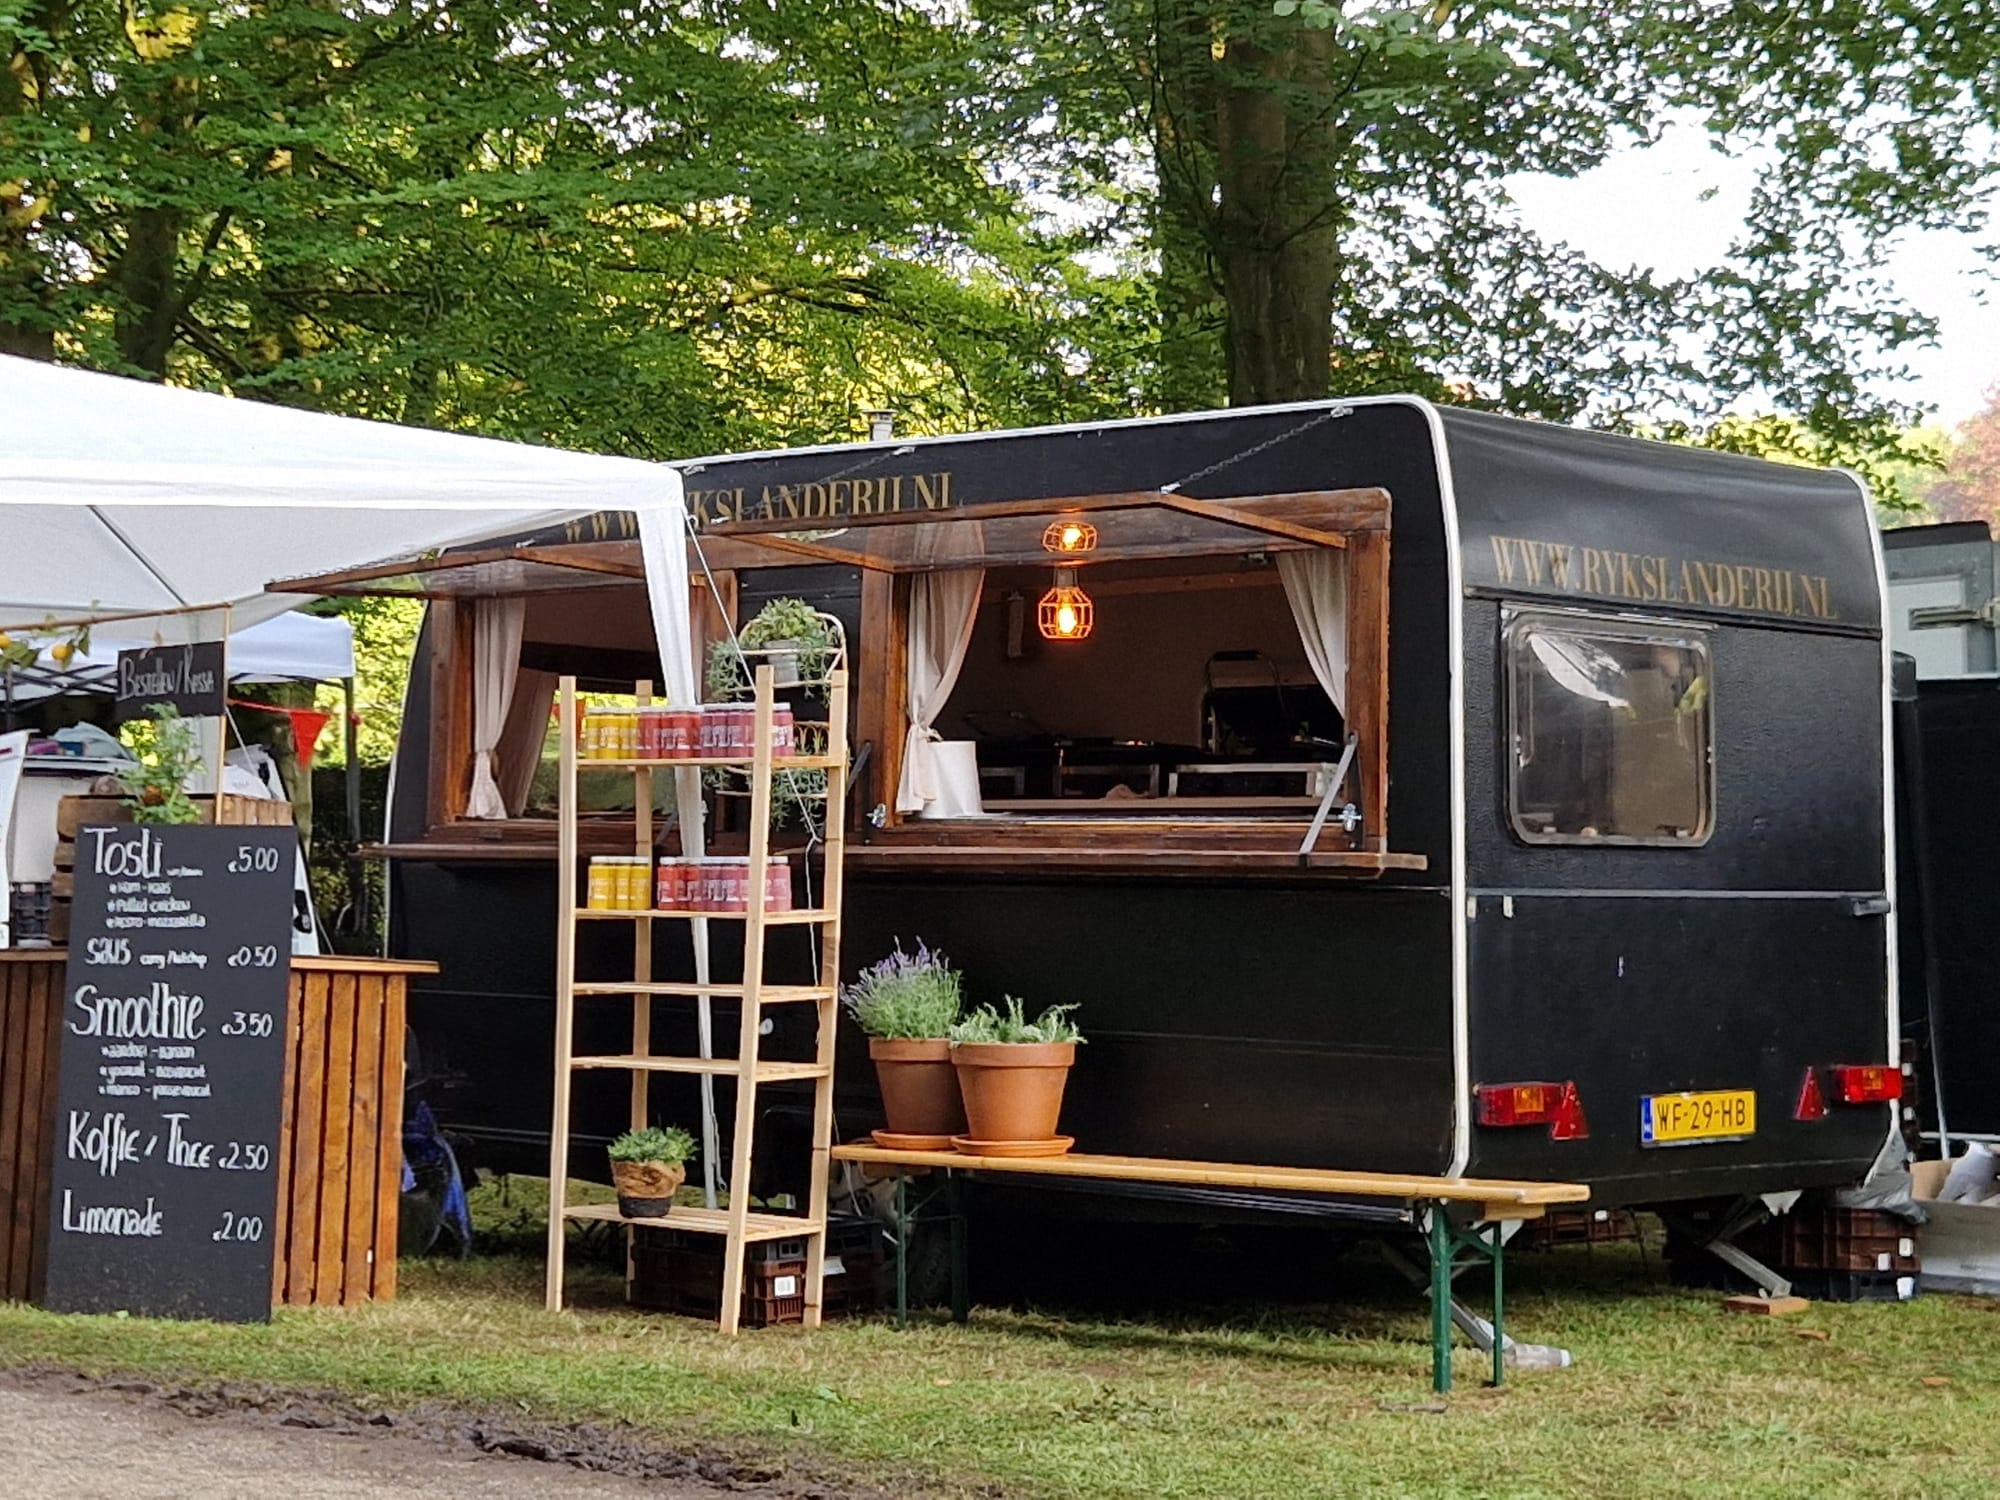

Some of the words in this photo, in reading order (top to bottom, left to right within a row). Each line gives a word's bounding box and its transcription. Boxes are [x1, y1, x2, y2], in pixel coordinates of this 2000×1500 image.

[1489, 535, 1840, 620] WWW.RYKSLANDERIJ.NL
[67, 982, 207, 1040] Smoothie
[1657, 1098, 1746, 1132] WF-29-HB
[62, 1189, 163, 1236] Limonade
